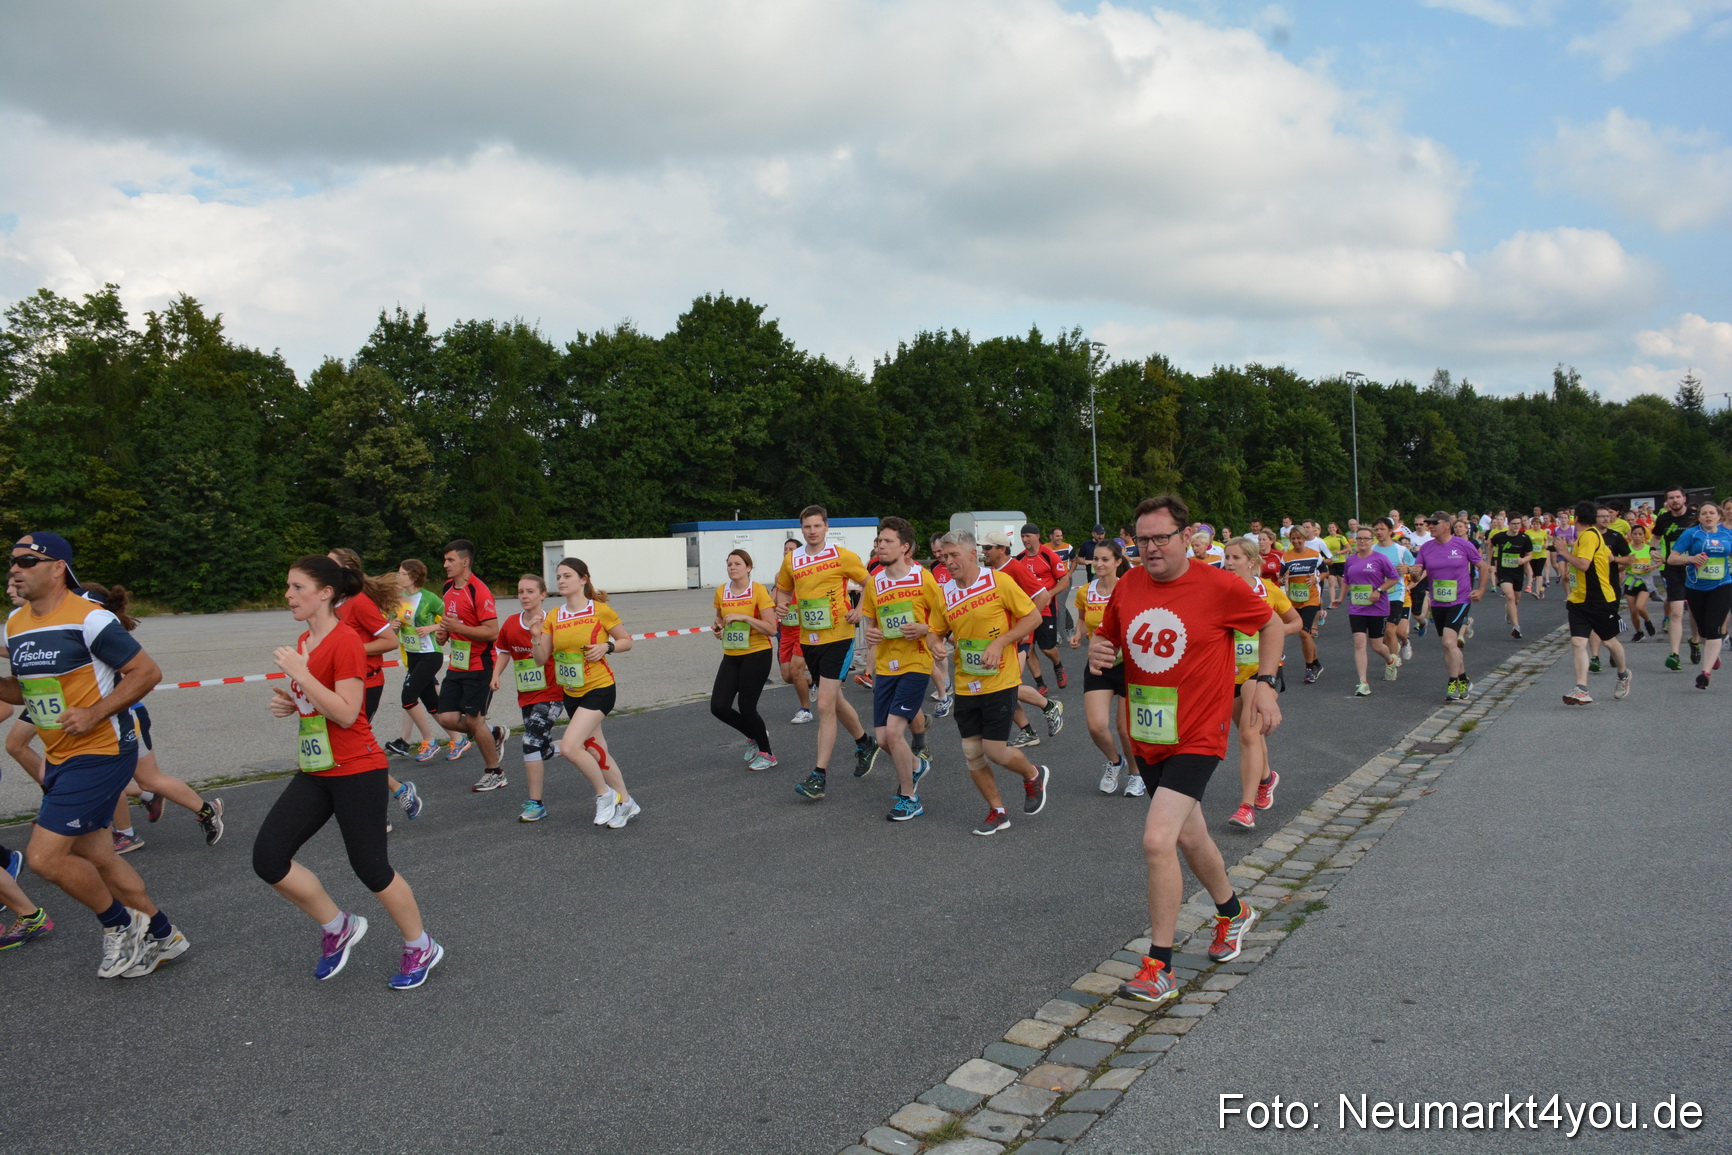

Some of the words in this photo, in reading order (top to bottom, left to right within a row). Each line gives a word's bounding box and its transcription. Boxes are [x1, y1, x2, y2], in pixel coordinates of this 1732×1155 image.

[794, 569, 813, 580] MAX
[816, 561, 842, 573] BÖGL
[1703, 566, 1720, 574] 458
[877, 593, 896, 605] MAX
[898, 589, 923, 598] BÖGL
[1437, 588, 1452, 596] 664
[948, 605, 969, 622] MAX
[971, 592, 1000, 609] BÖGL
[804, 610, 824, 621] 932
[886, 615, 908, 629] 884
[555, 622, 571, 630] MAX
[574, 618, 595, 626] BÖGL
[727, 632, 744, 641] 858
[19, 649, 60, 662] Fischer
[518, 670, 542, 683] 1420
[559, 664, 577, 678] 886
[1137, 708, 1163, 728] 501
[301, 739, 322, 757] 496
